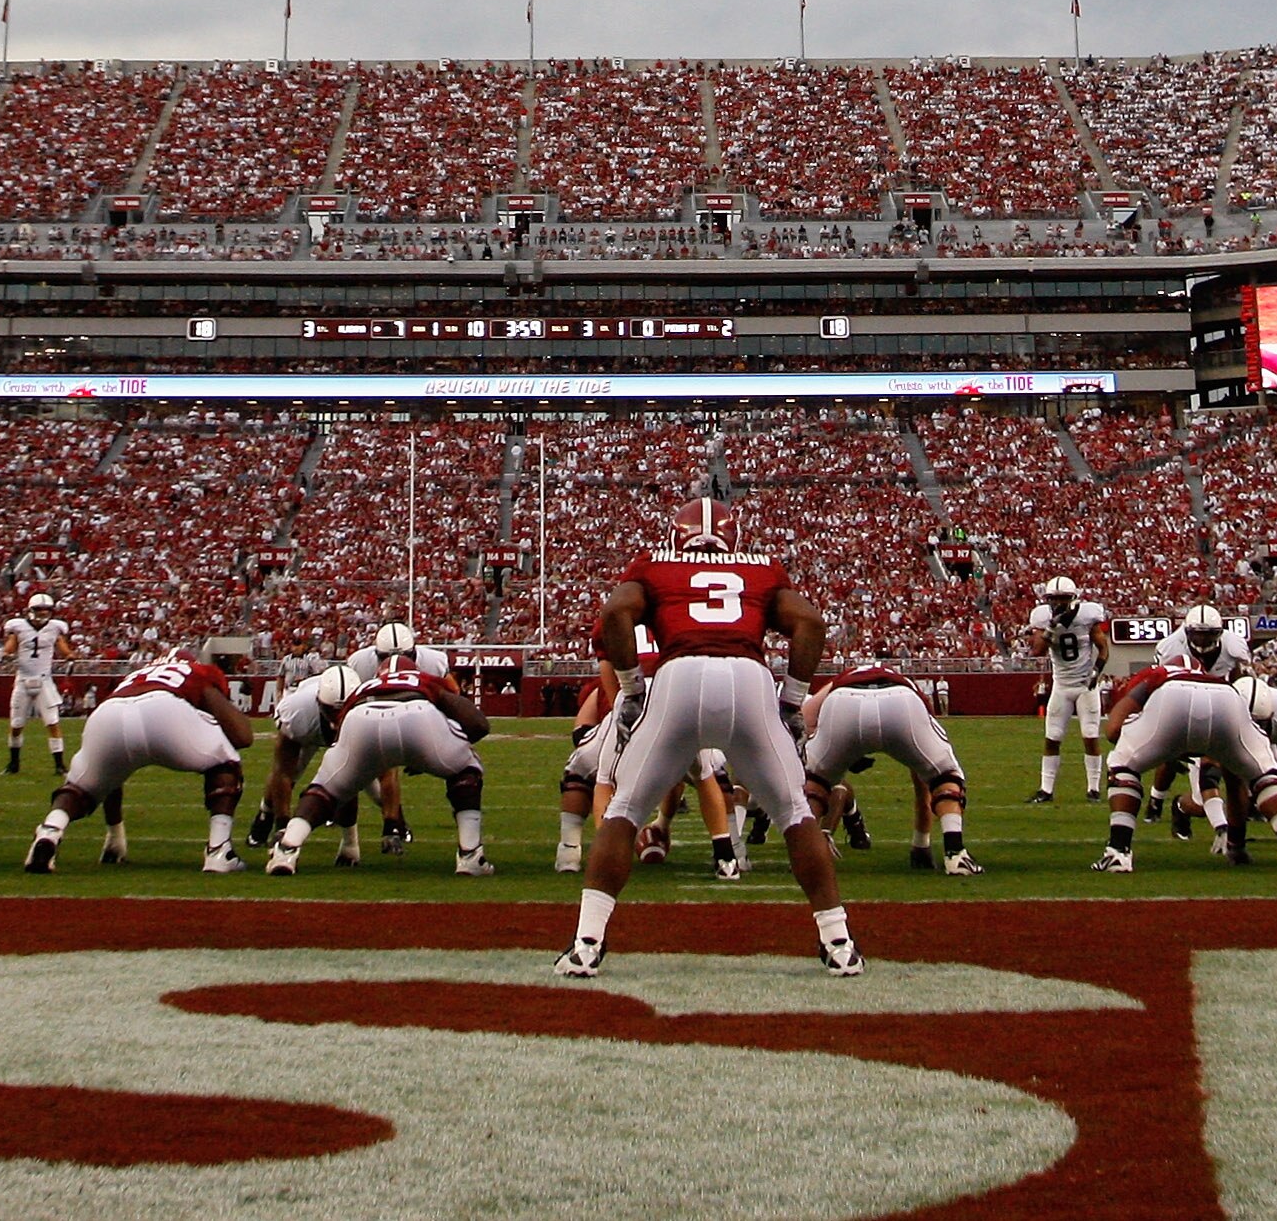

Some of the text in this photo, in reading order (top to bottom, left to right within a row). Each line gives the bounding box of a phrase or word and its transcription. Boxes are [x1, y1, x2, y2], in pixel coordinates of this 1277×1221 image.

[194, 321, 214, 337] 18
[303, 320, 315, 338] 3
[467, 320, 484, 337] 10
[506, 320, 541, 337] 3:59
[582, 320, 593, 337] 3
[721, 319, 733, 337] 2
[828, 319, 846, 336] 18
[118, 379, 148, 394] TIDE
[497, 379, 536, 395] WITH
[538, 379, 571, 394] THE
[574, 379, 612, 394] TIDE
[1004, 376, 1034, 391] TIDE
[688, 571, 746, 623] 3
[1129, 620, 1168, 640] 3:59
[29, 636, 41, 659] 1
[1059, 633, 1079, 661] 8
[454, 656, 515, 667] BAMA
